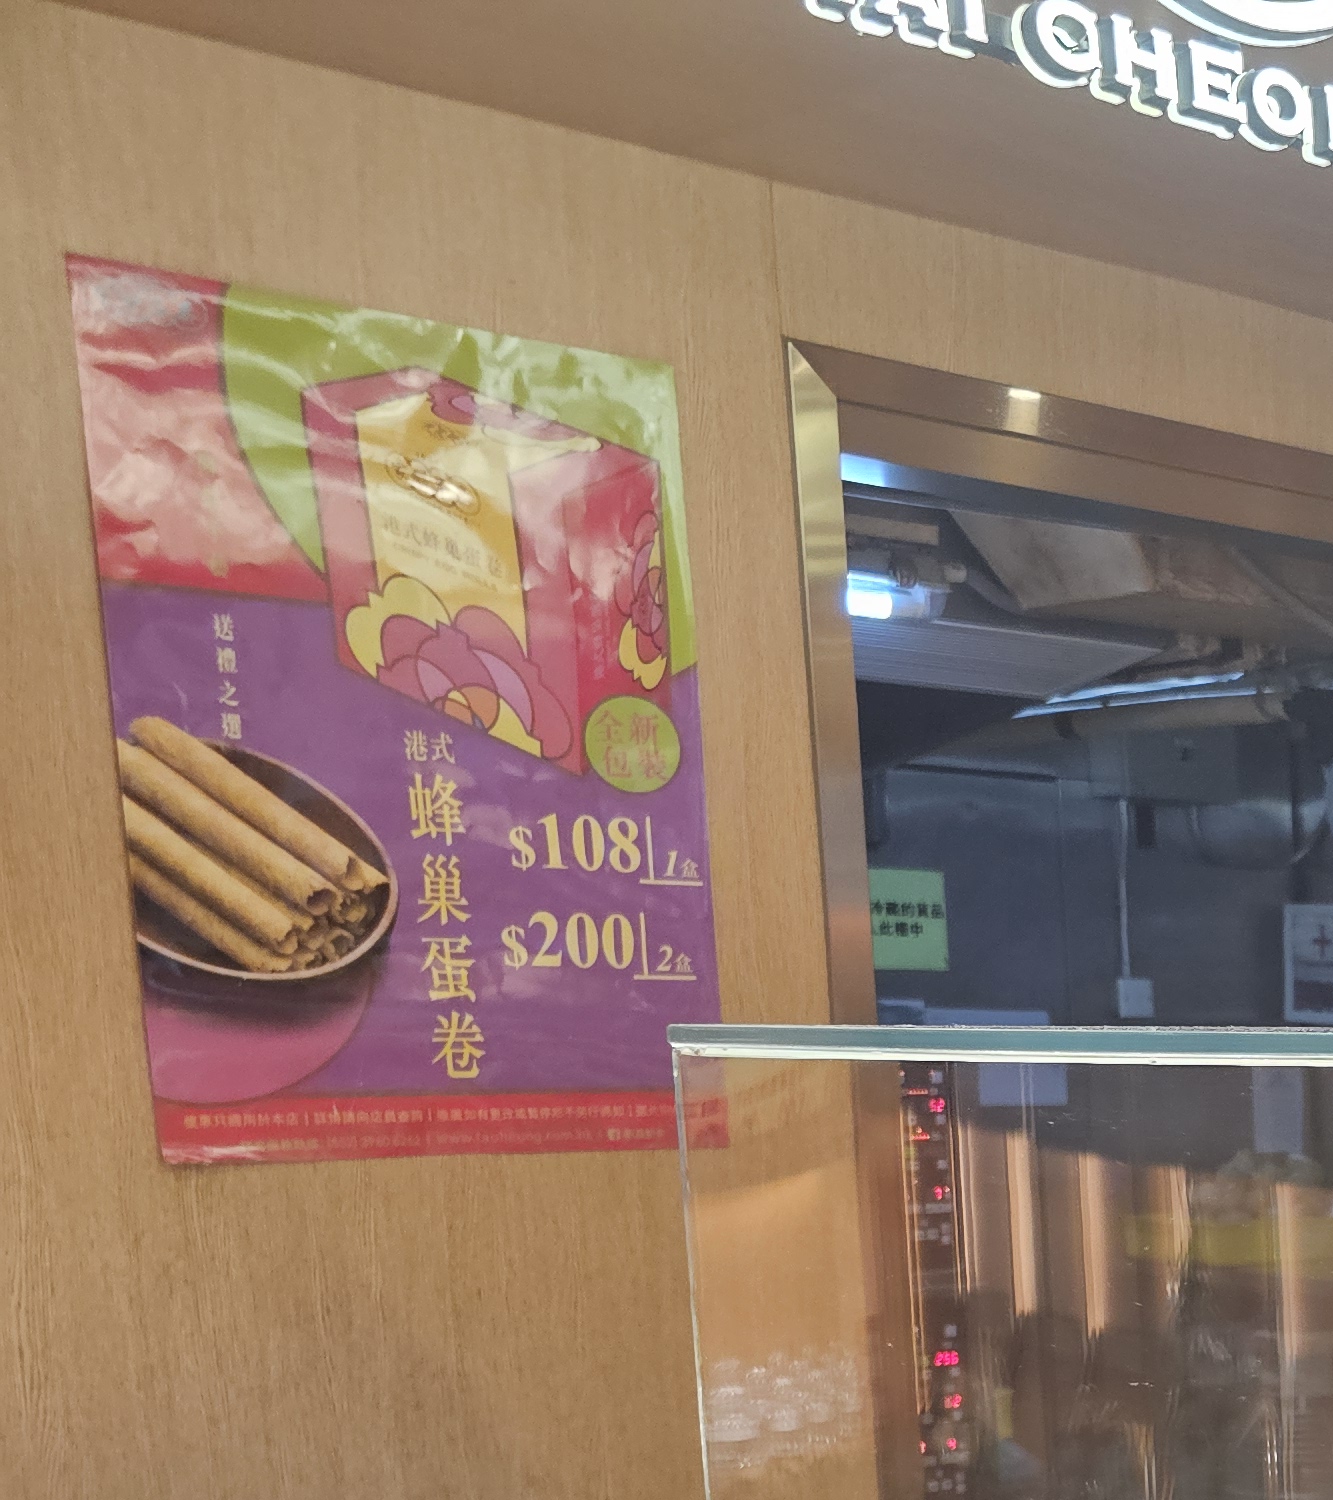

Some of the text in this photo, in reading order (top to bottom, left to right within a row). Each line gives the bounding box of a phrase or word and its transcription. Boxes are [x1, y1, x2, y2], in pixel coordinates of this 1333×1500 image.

[402, 730, 455, 765] 港式
[509, 813, 642, 873] $108
[408, 772, 486, 1079] 蜂巢蛋卷
[501, 911, 634, 969] $200
